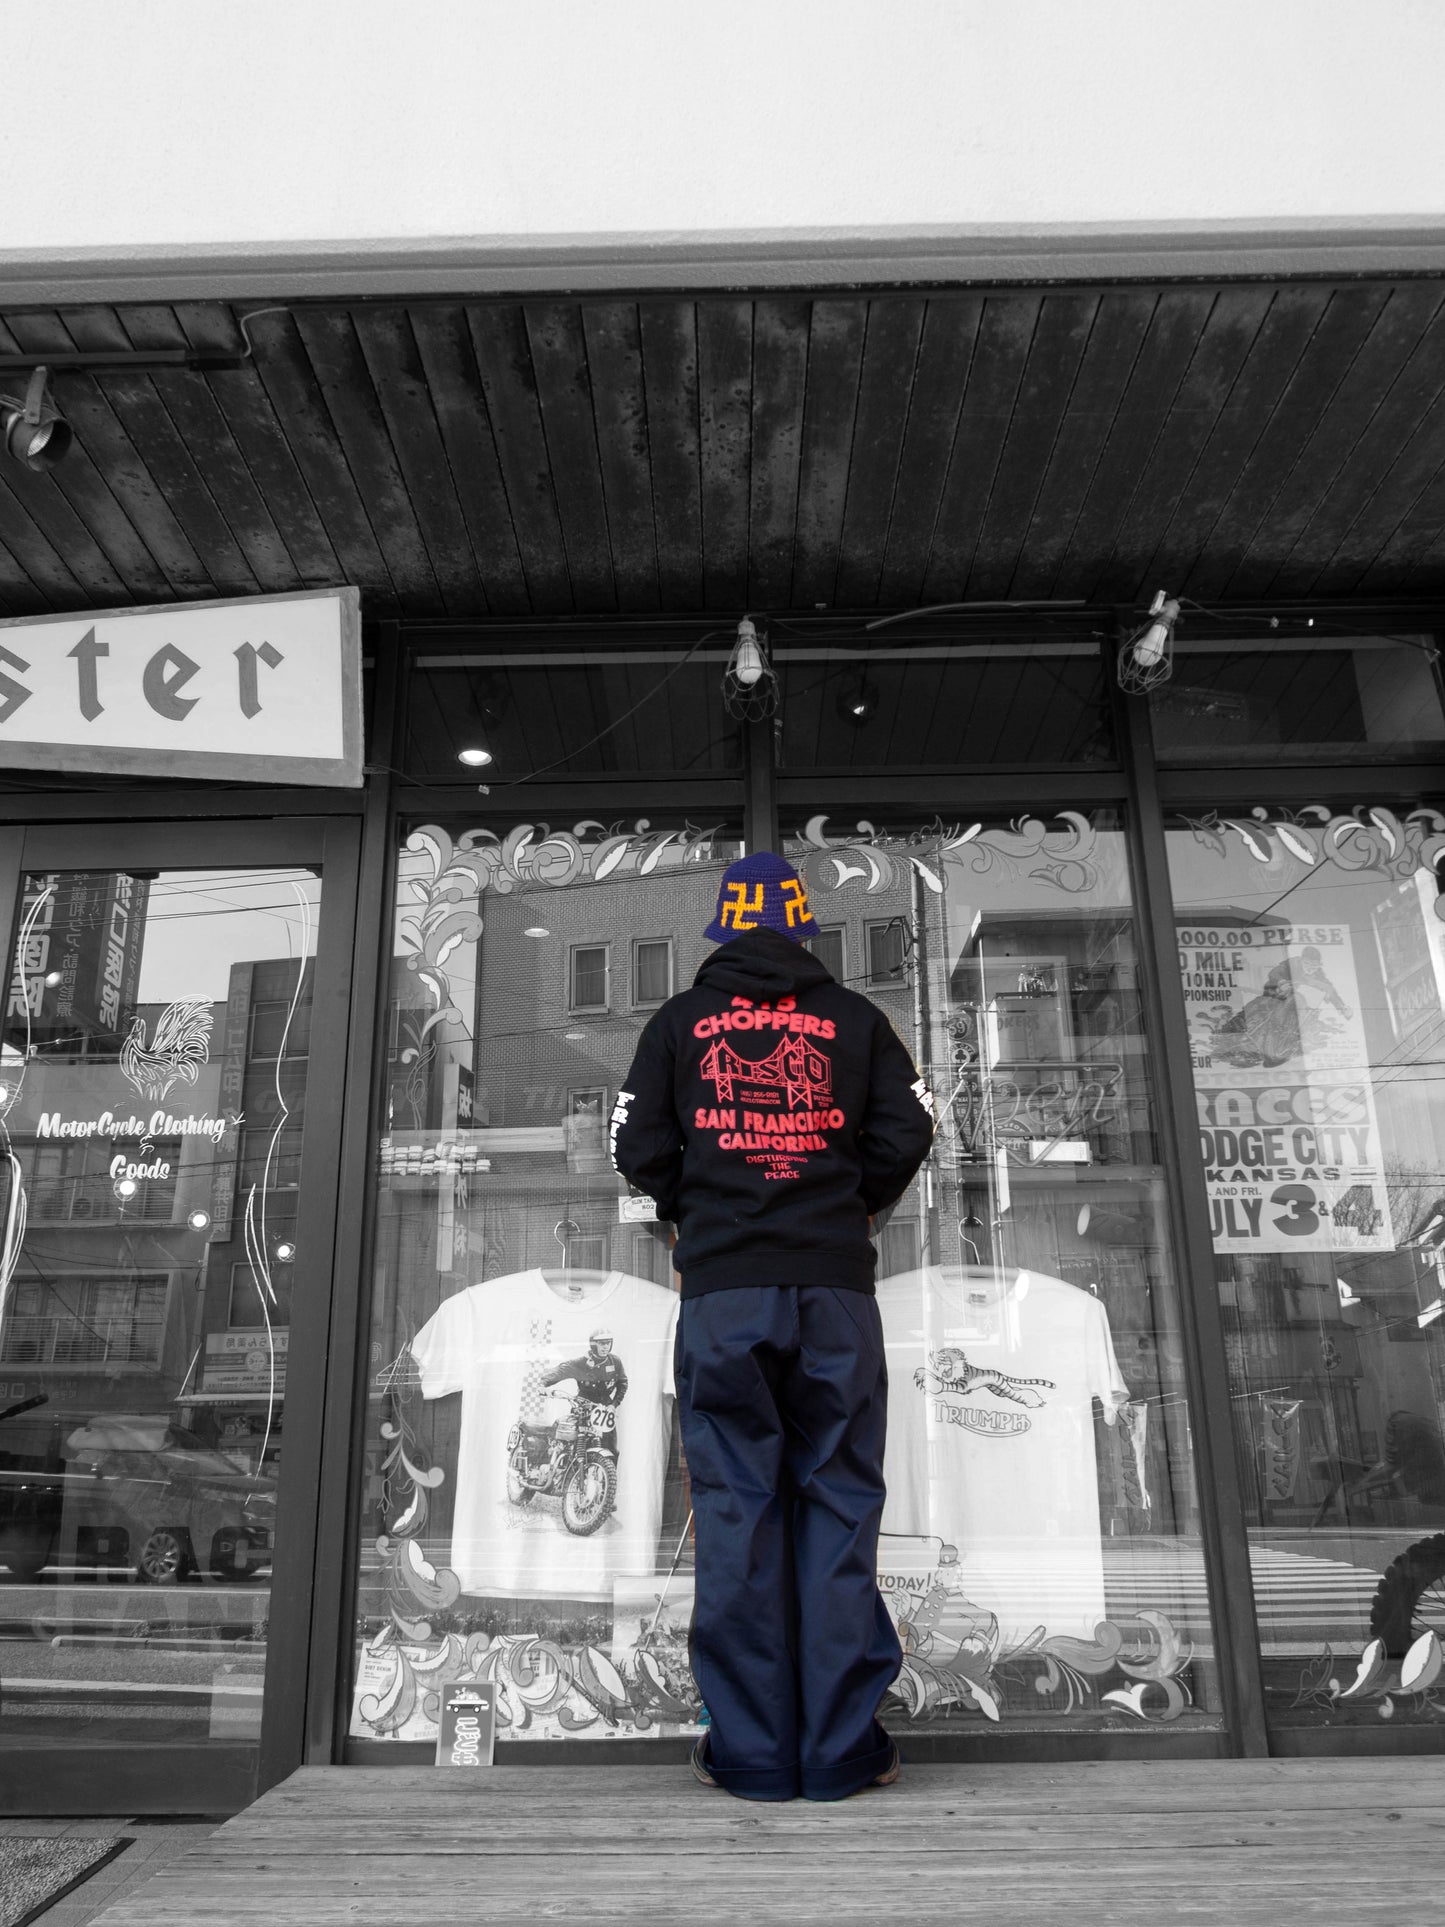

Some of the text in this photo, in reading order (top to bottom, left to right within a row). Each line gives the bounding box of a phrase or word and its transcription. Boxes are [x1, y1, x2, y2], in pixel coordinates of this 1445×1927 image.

[1262, 928, 1344, 945] PURSE
[1195, 952, 1244, 972] MILE
[1184, 989, 1232, 1002] PIONSHIP
[693, 1009, 836, 1040] CHOPPERS
[700, 1050, 829, 1088] FRISCO
[149, 1110, 227, 1143] Clothing
[694, 1108, 845, 1134] SAN FRANCISCO
[718, 1132, 828, 1152] CALIFORNIA
[1292, 1126, 1371, 1166] CITY
[110, 1155, 171, 1180] Goods
[764, 1170, 800, 1180] PEACE
[769, 1162, 791, 1170] THE
[1207, 1167, 1341, 1183] KANSAS
[1216, 1186, 1262, 1196] AND FRI.
[1270, 1184, 1320, 1236] 3
[1318, 1201, 1329, 1217] &
[1332, 1185, 1384, 1236] 4
[592, 1408, 615, 1428] 278
[933, 1400, 1032, 1432] TRIUMPH
[878, 1572, 932, 1593] TODAY!
